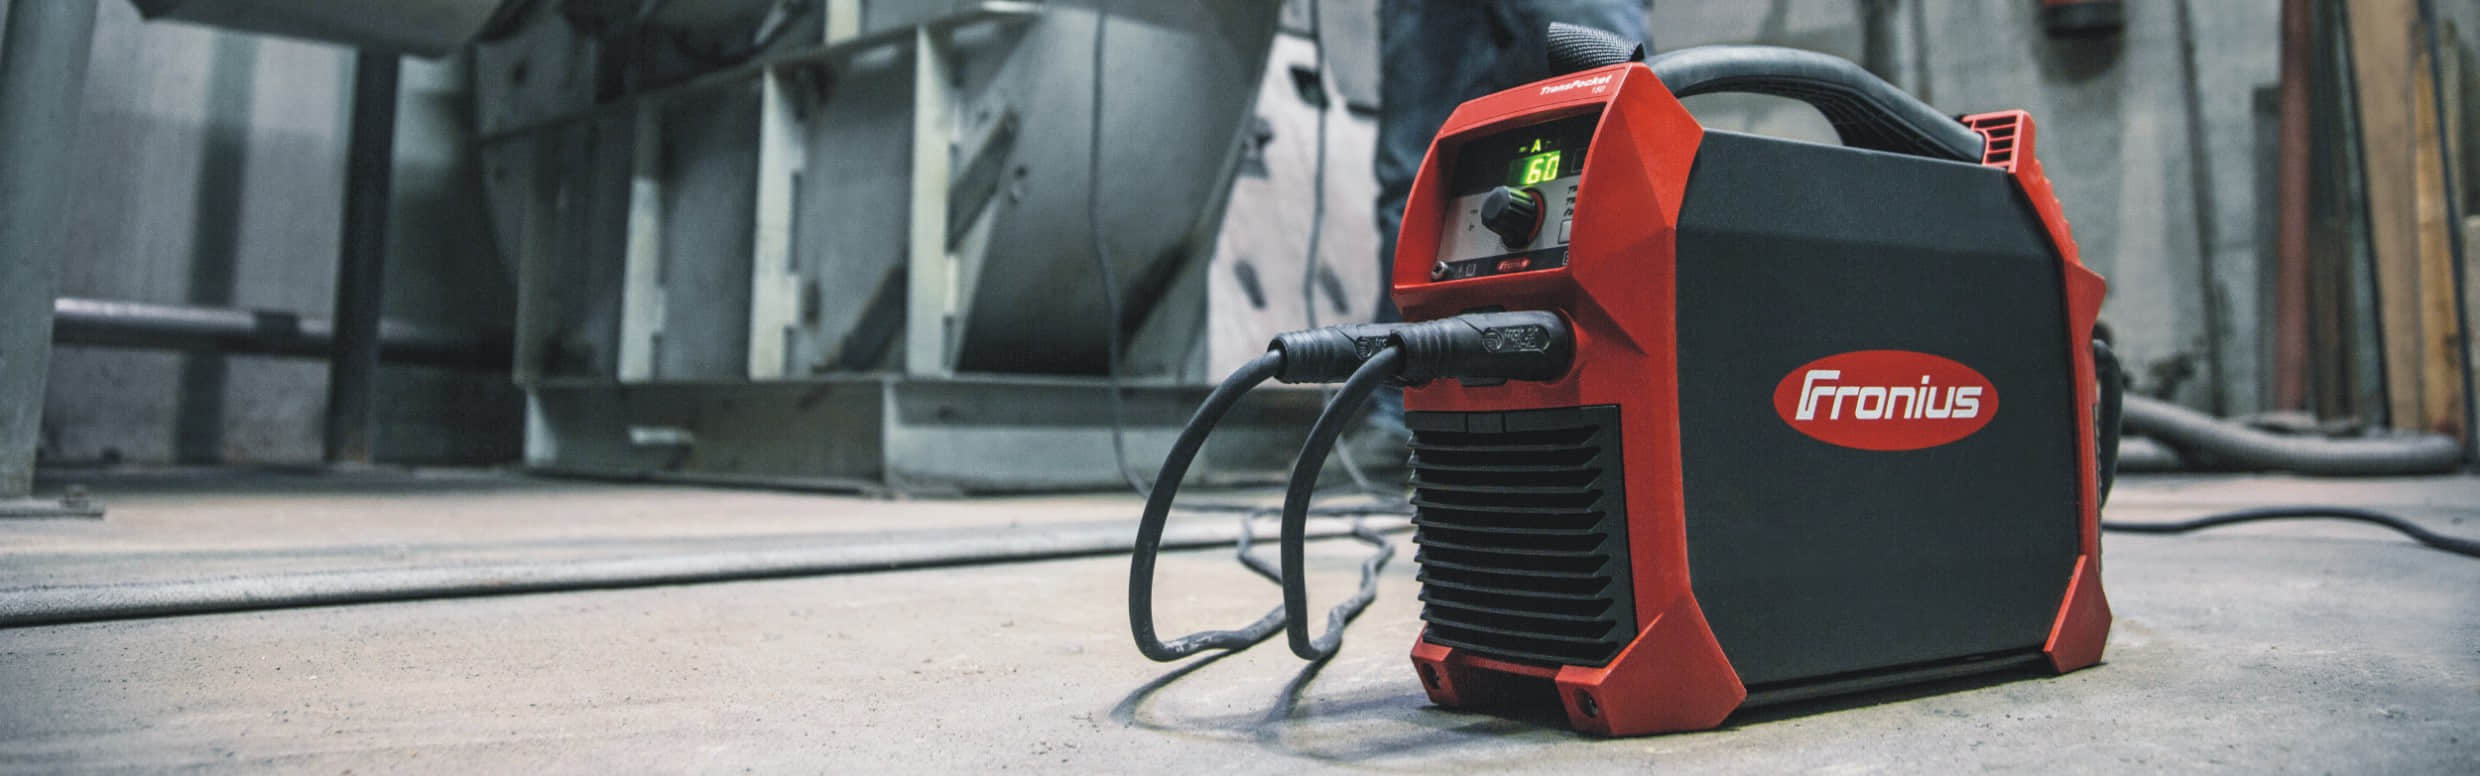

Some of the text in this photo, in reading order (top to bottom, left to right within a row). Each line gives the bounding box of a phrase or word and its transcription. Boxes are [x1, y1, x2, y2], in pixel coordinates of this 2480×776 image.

[1540, 74, 1612, 95] TransPocket
[1527, 154, 1560, 184] 60
[1795, 369, 1983, 420] Fronius
